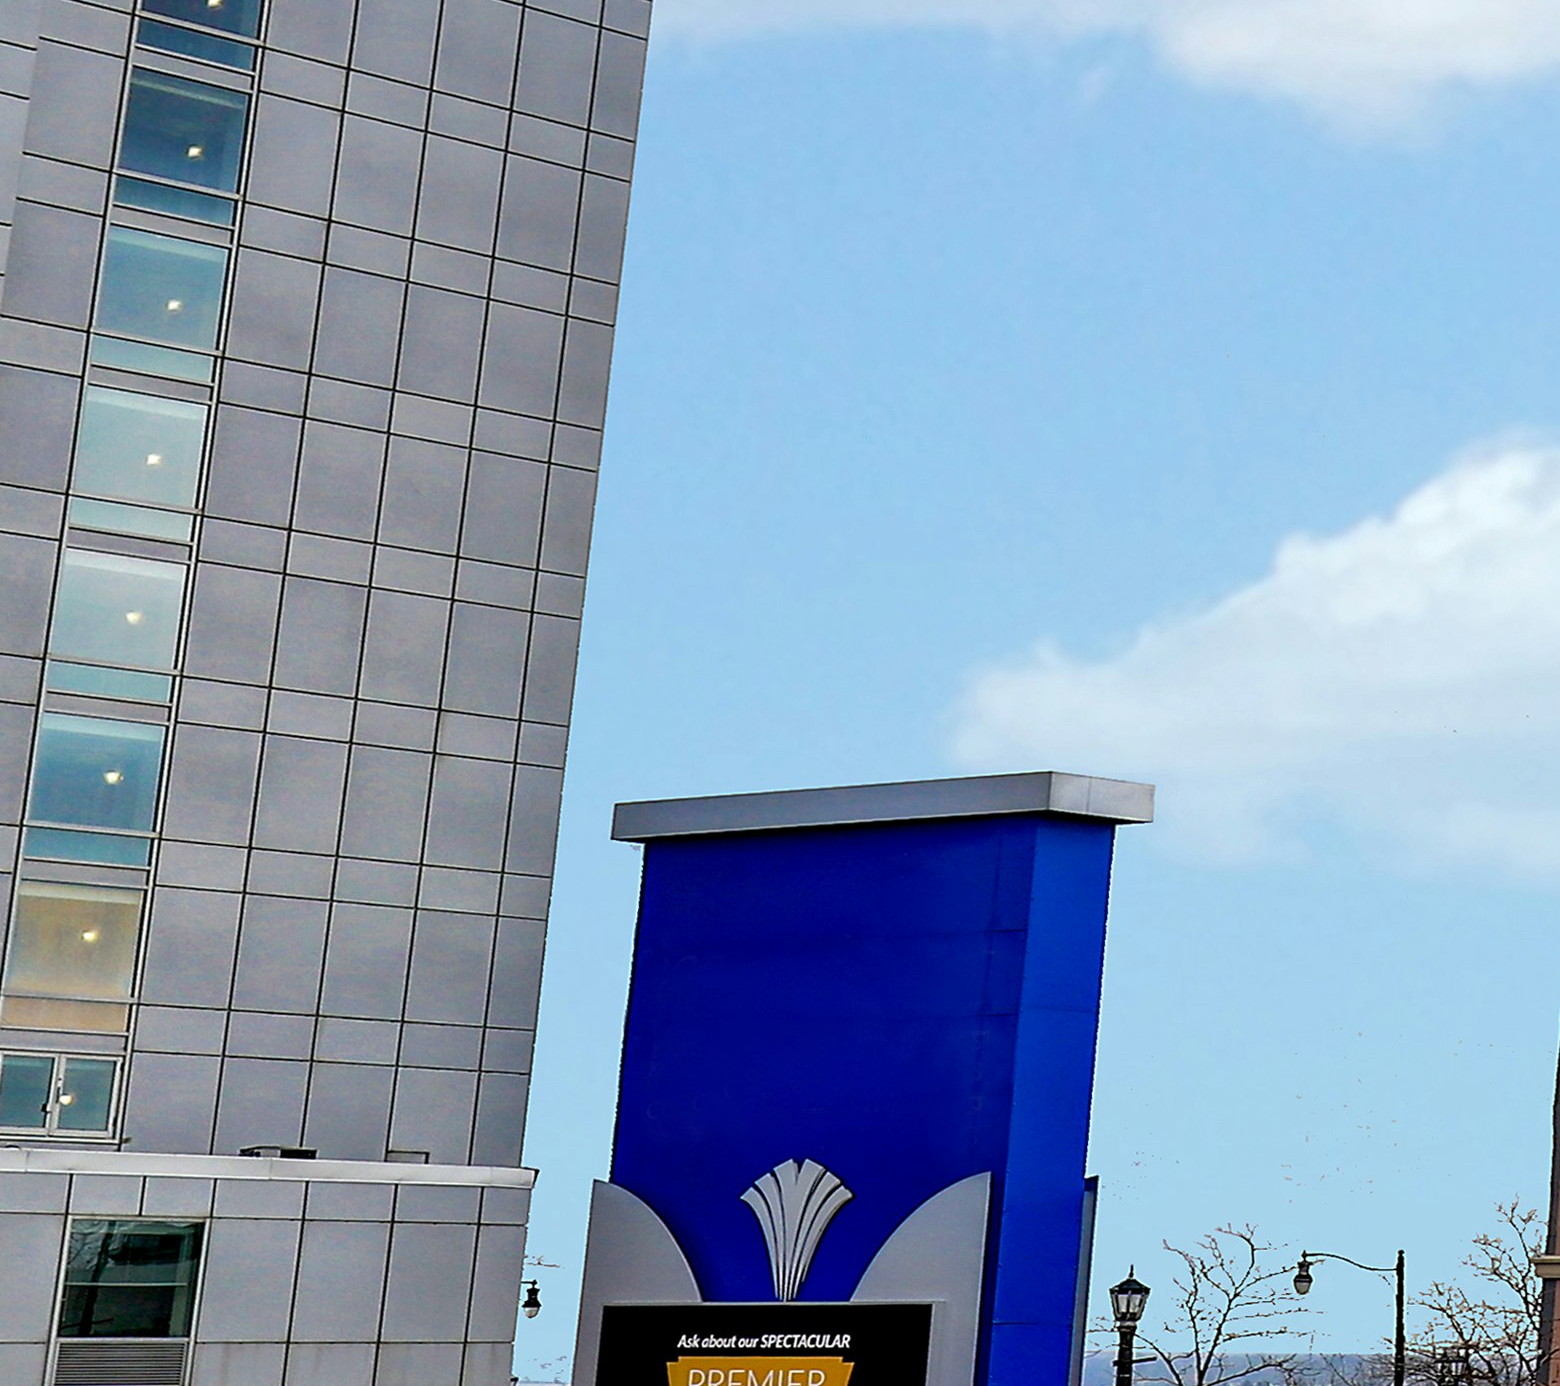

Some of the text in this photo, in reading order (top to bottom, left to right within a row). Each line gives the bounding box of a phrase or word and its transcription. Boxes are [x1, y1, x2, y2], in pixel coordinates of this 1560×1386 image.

[677, 1334, 851, 1348] Ask about our SPECTACULAR
